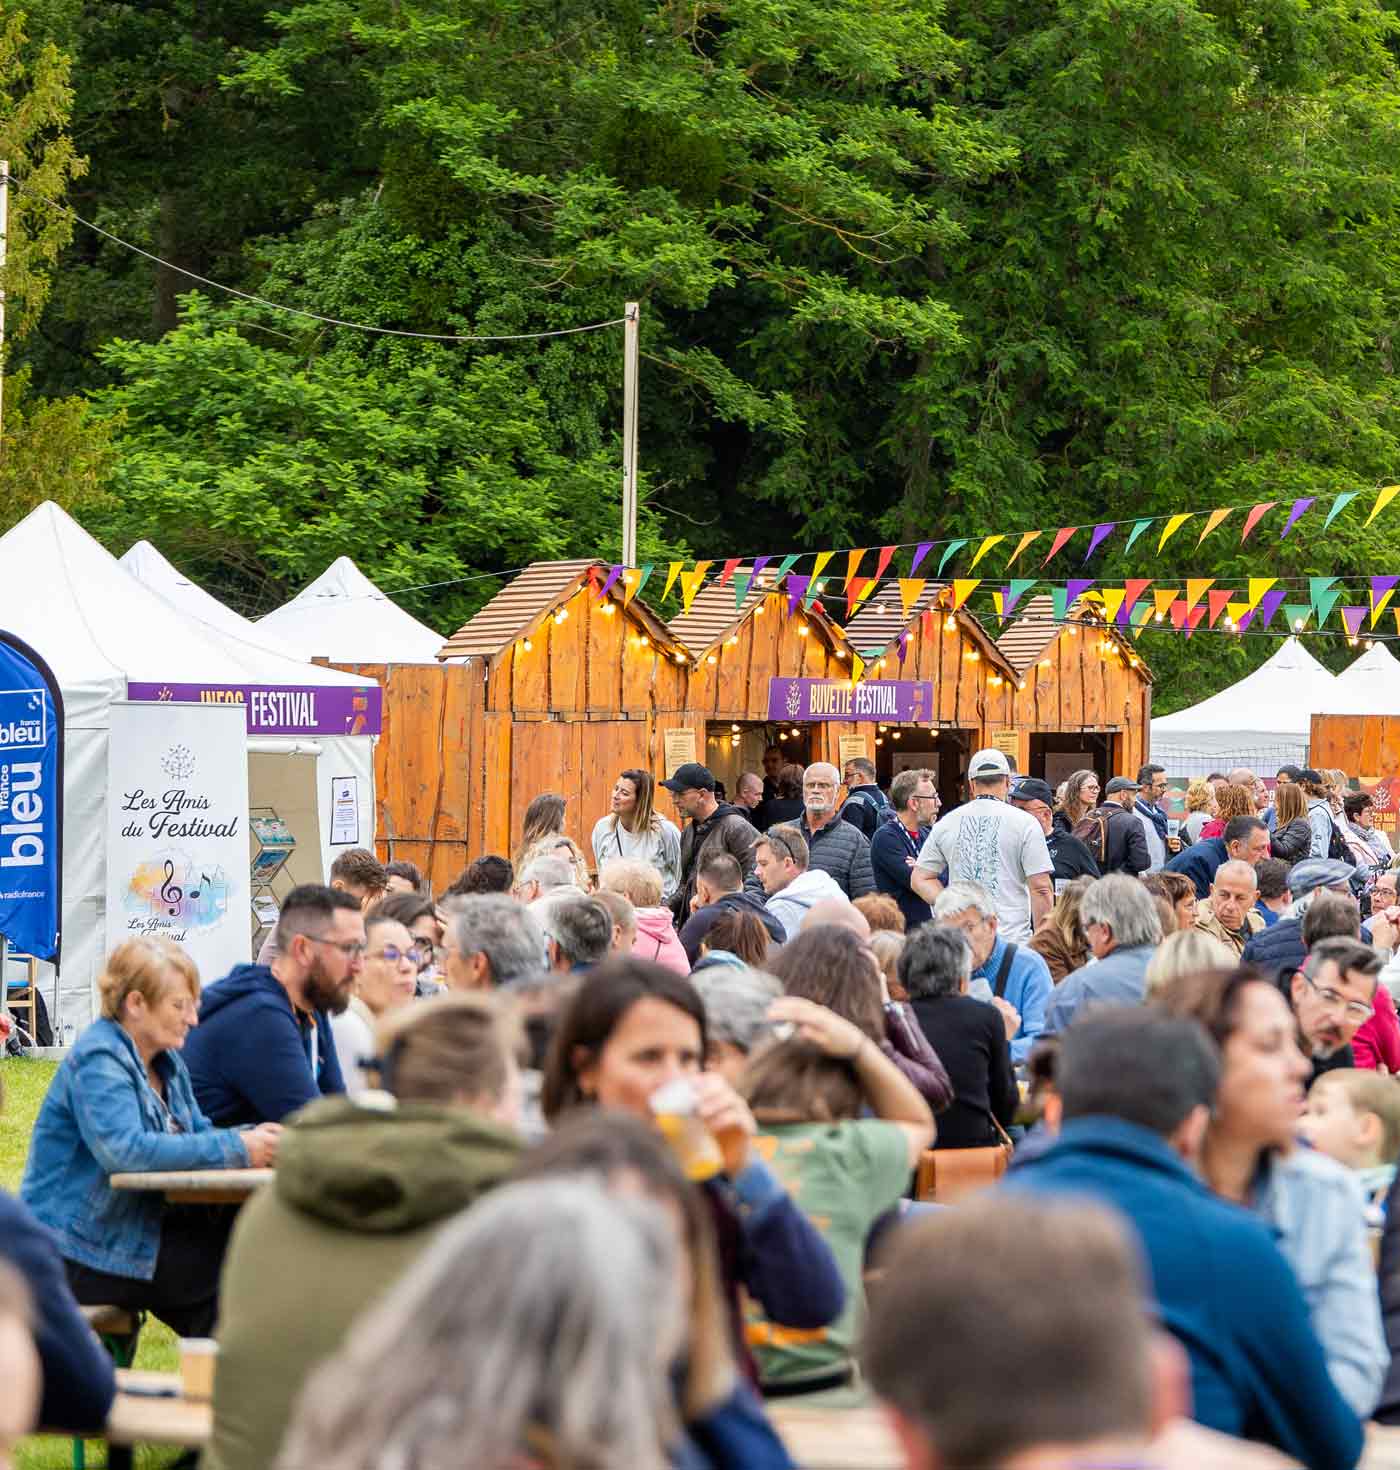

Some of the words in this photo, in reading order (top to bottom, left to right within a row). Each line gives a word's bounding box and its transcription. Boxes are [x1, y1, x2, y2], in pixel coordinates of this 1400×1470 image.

[251, 690, 319, 727] FESTIVAL
[809, 684, 852, 714] BUVETTE
[856, 685, 898, 715] FESTIVAL
[1, 762, 44, 867] bleu
[121, 789, 157, 811] Les
[162, 789, 210, 812] Amis
[121, 821, 144, 838] du
[148, 810, 239, 839] Festival
[127, 919, 145, 929] Les
[146, 918, 173, 929] Amis
